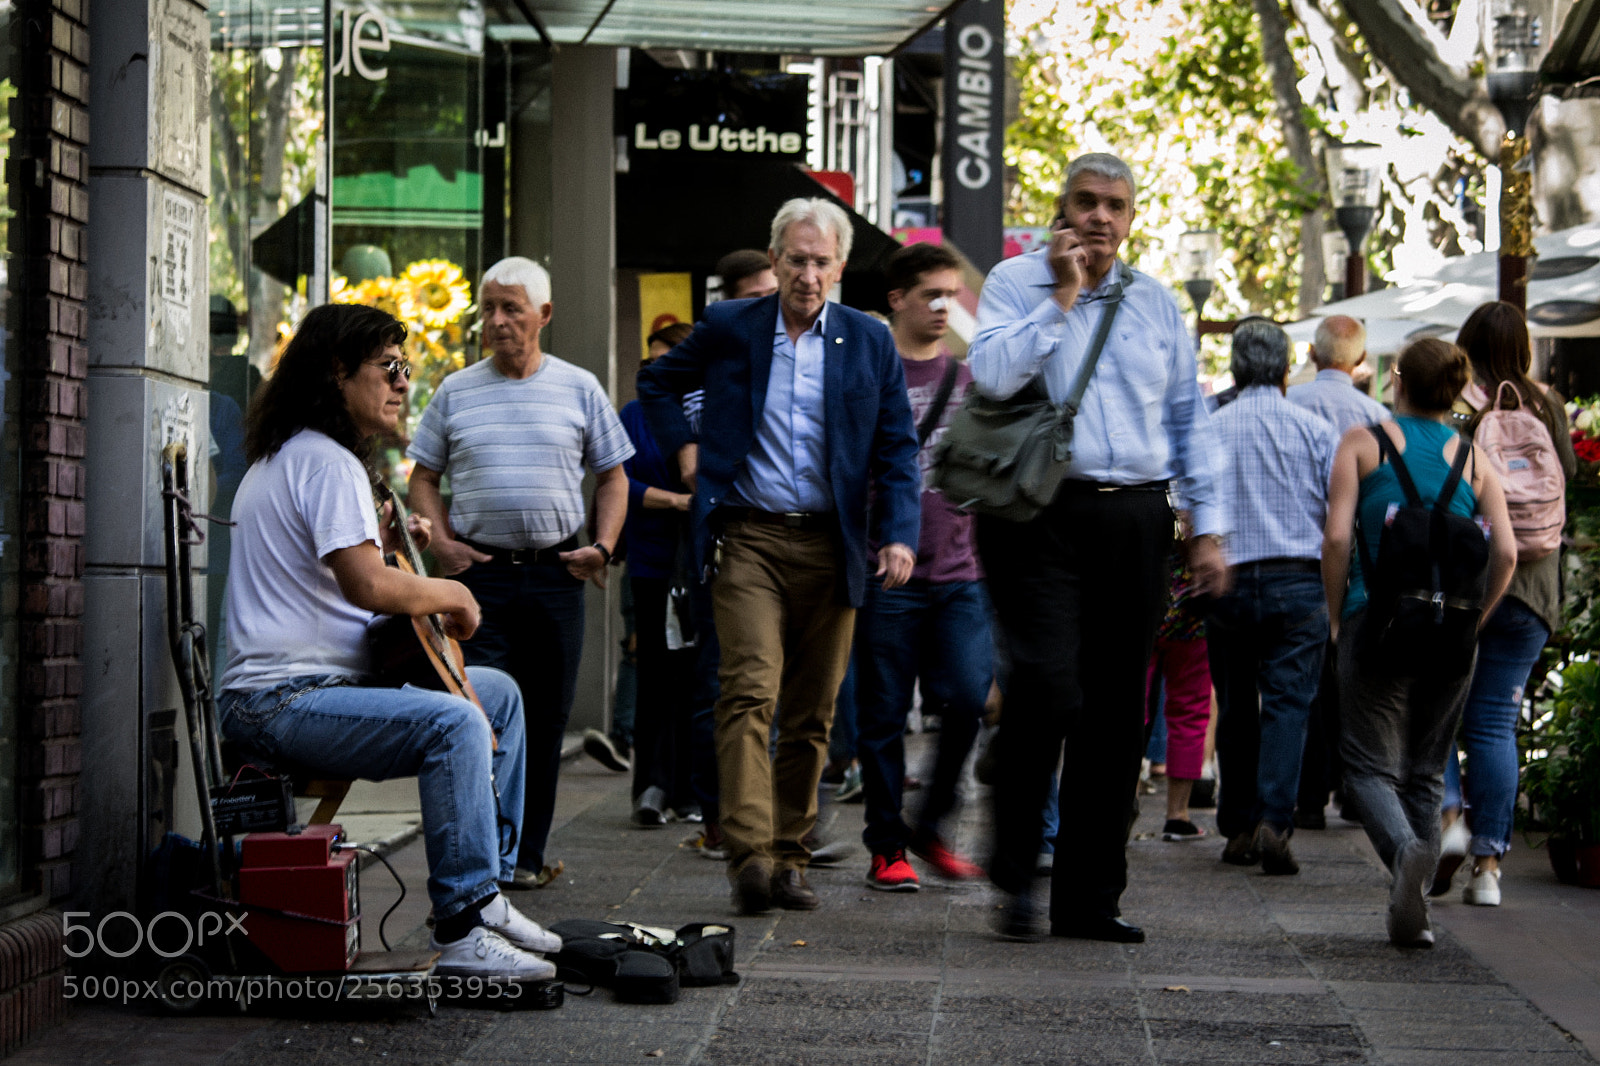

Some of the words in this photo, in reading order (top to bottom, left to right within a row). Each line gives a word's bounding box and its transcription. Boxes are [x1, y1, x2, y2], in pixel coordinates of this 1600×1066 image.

[634, 122, 682, 150] Le
[688, 123, 802, 154] Utthe
[956, 24, 993, 190] CAMBIO
